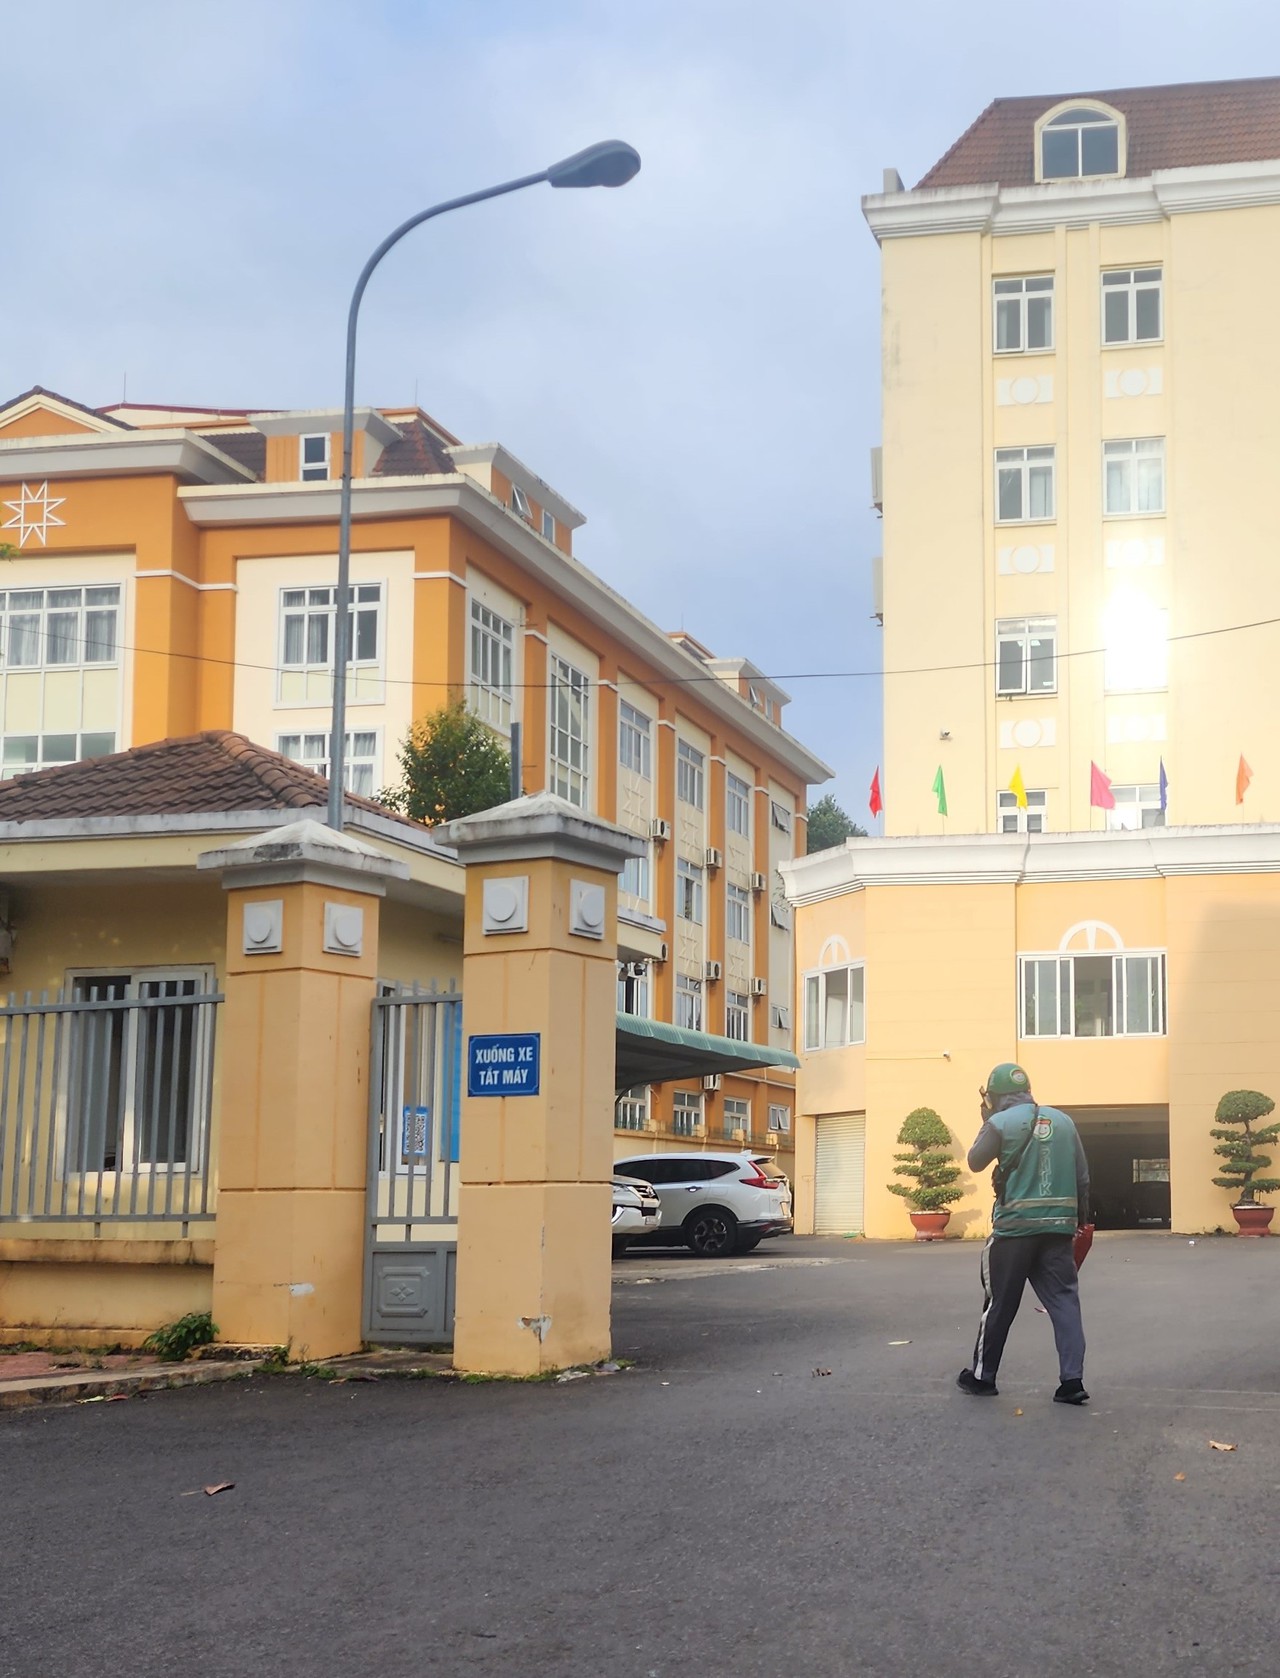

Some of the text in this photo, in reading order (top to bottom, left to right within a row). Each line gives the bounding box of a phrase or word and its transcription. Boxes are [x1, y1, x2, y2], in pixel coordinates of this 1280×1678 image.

[475, 1043, 534, 1064] XUỐNG XE
[478, 1065, 529, 1086] TẮT MÁY
